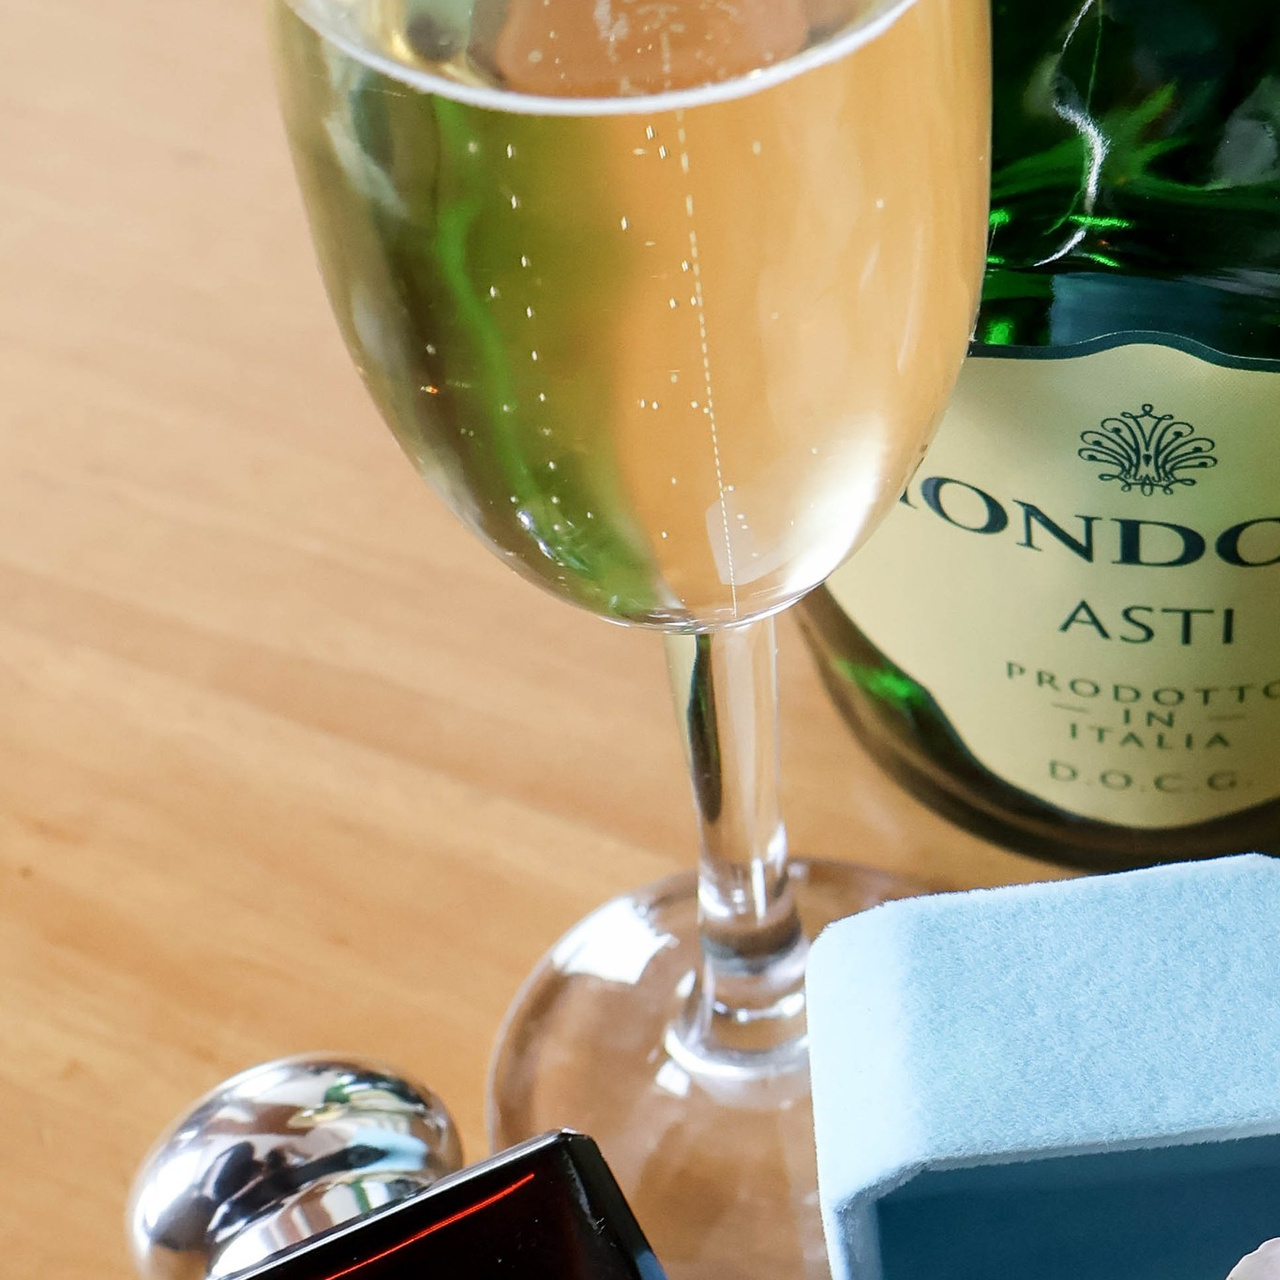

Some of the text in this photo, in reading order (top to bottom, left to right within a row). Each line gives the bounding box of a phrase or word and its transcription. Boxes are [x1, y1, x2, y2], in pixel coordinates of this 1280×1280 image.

[1059, 600, 1235, 646] ASTI
[1122, 707, 1176, 729] IN
[1069, 722, 1231, 751] ITALIA
